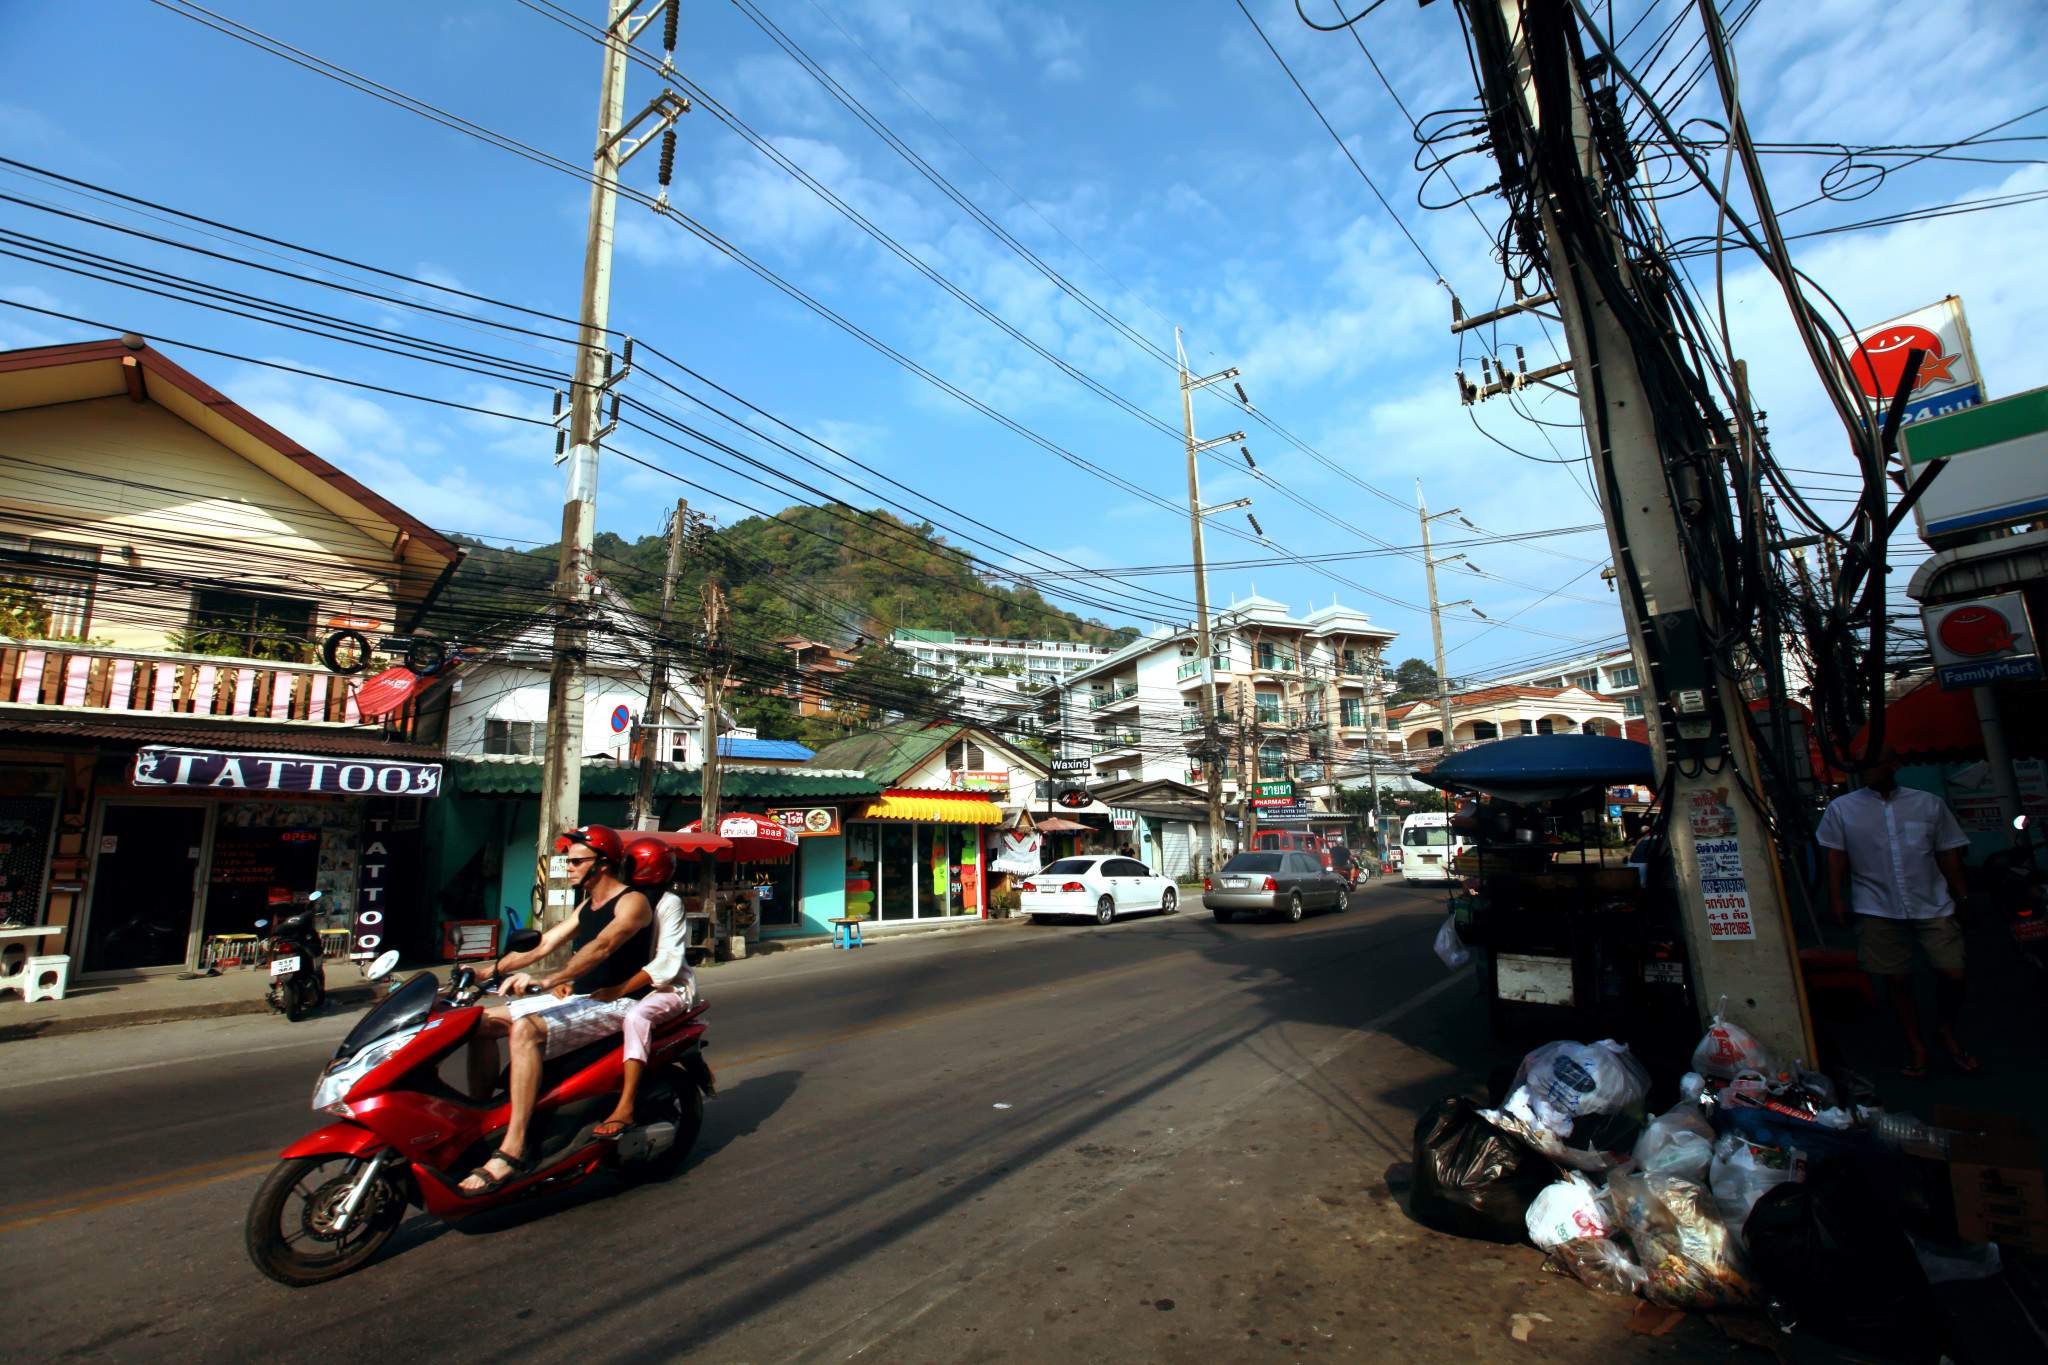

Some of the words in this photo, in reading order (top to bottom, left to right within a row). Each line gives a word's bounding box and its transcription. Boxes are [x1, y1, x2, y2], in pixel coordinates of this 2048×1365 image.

[1944, 661, 2036, 684] FamilyMart
[1051, 759, 1089, 770] Waxing
[164, 753, 411, 794] TATTOO
[1262, 784, 1292, 796] ขายยา
[1255, 798, 1291, 806] PHARMACY
[785, 811, 804, 825] โรตี
[281, 831, 317, 842] OPEN
[760, 827, 782, 837] วอลล์
[358, 818, 388, 949] TATTOO
[1705, 893, 1746, 909] รถรับจ้าง
[1732, 909, 1748, 920] ล้อ
